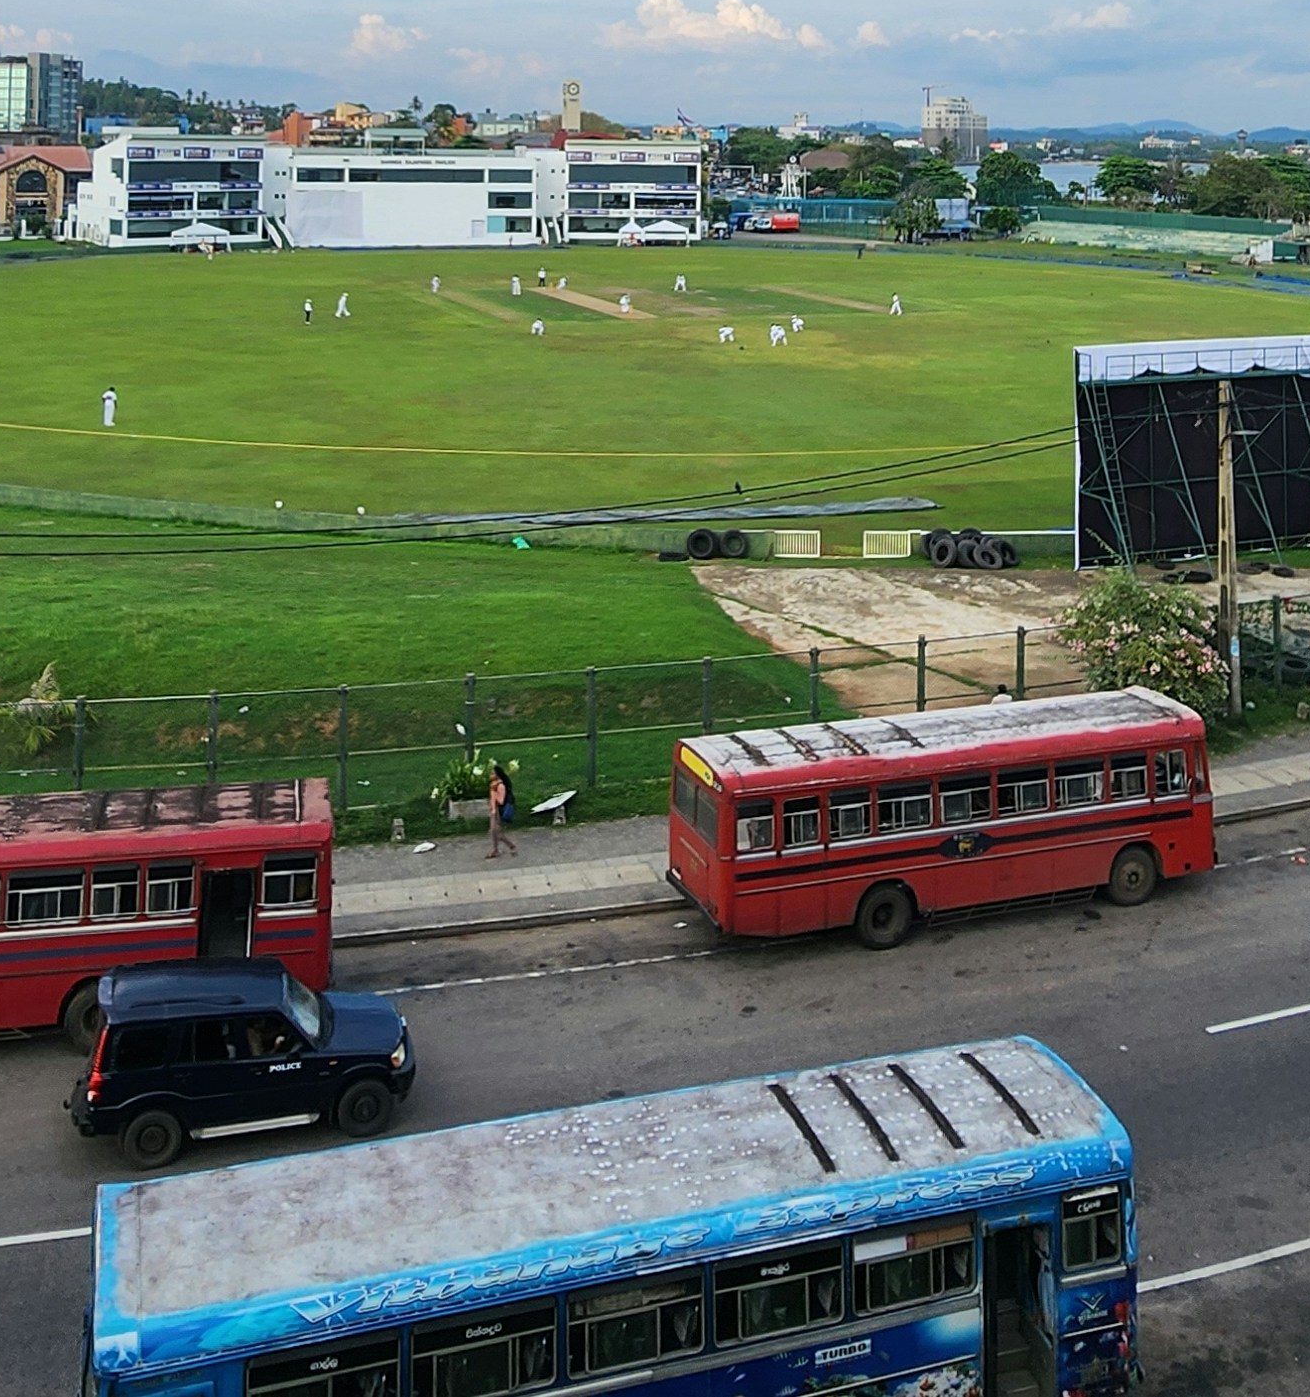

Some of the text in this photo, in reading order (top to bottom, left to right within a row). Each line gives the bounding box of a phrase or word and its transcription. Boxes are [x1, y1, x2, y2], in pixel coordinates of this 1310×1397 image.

[269, 1062, 302, 1073] POLICE
[735, 1165, 1035, 1236] Express
[821, 1343, 868, 1361] TURBO
